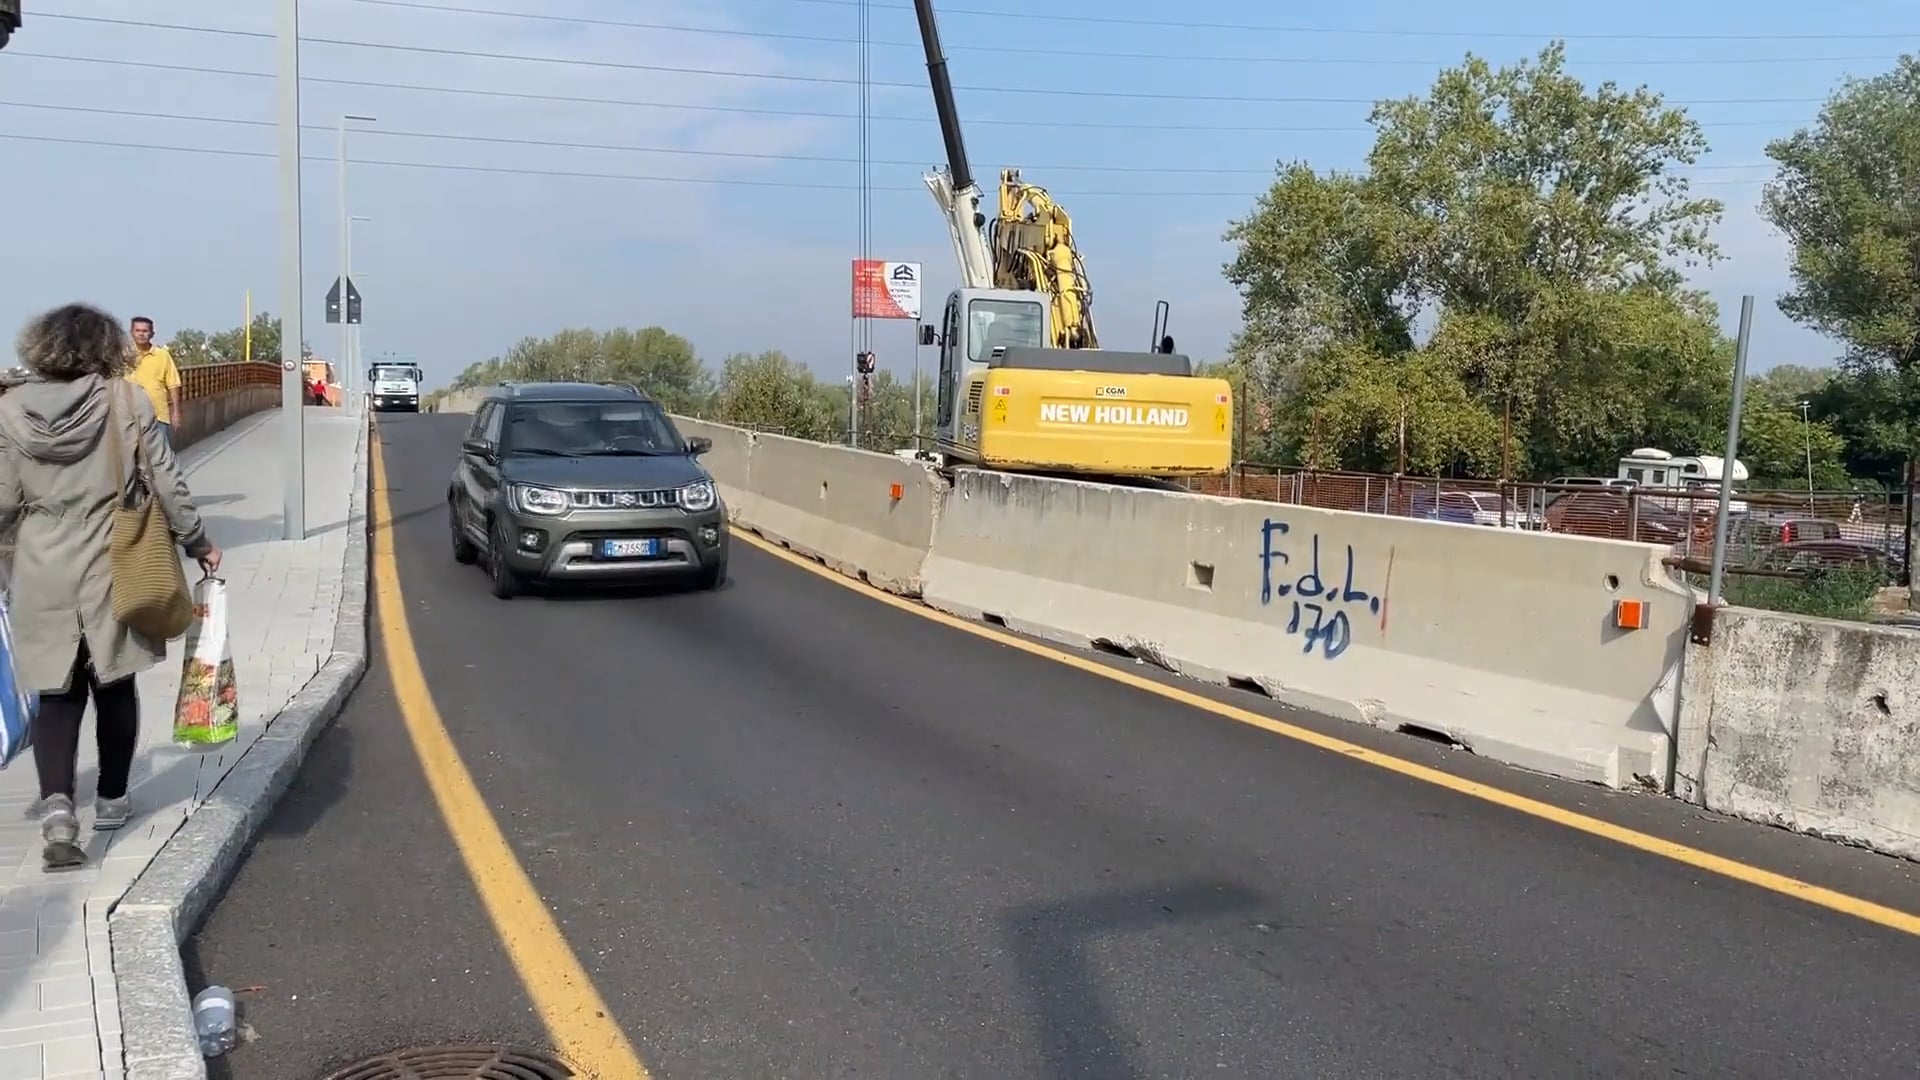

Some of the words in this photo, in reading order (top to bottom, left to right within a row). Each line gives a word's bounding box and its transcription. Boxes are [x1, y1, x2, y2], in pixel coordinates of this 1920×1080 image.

[1040, 404, 1090, 424] NEW
[1095, 405, 1189, 427] HOLLAND
[1287, 601, 1351, 660] 170
